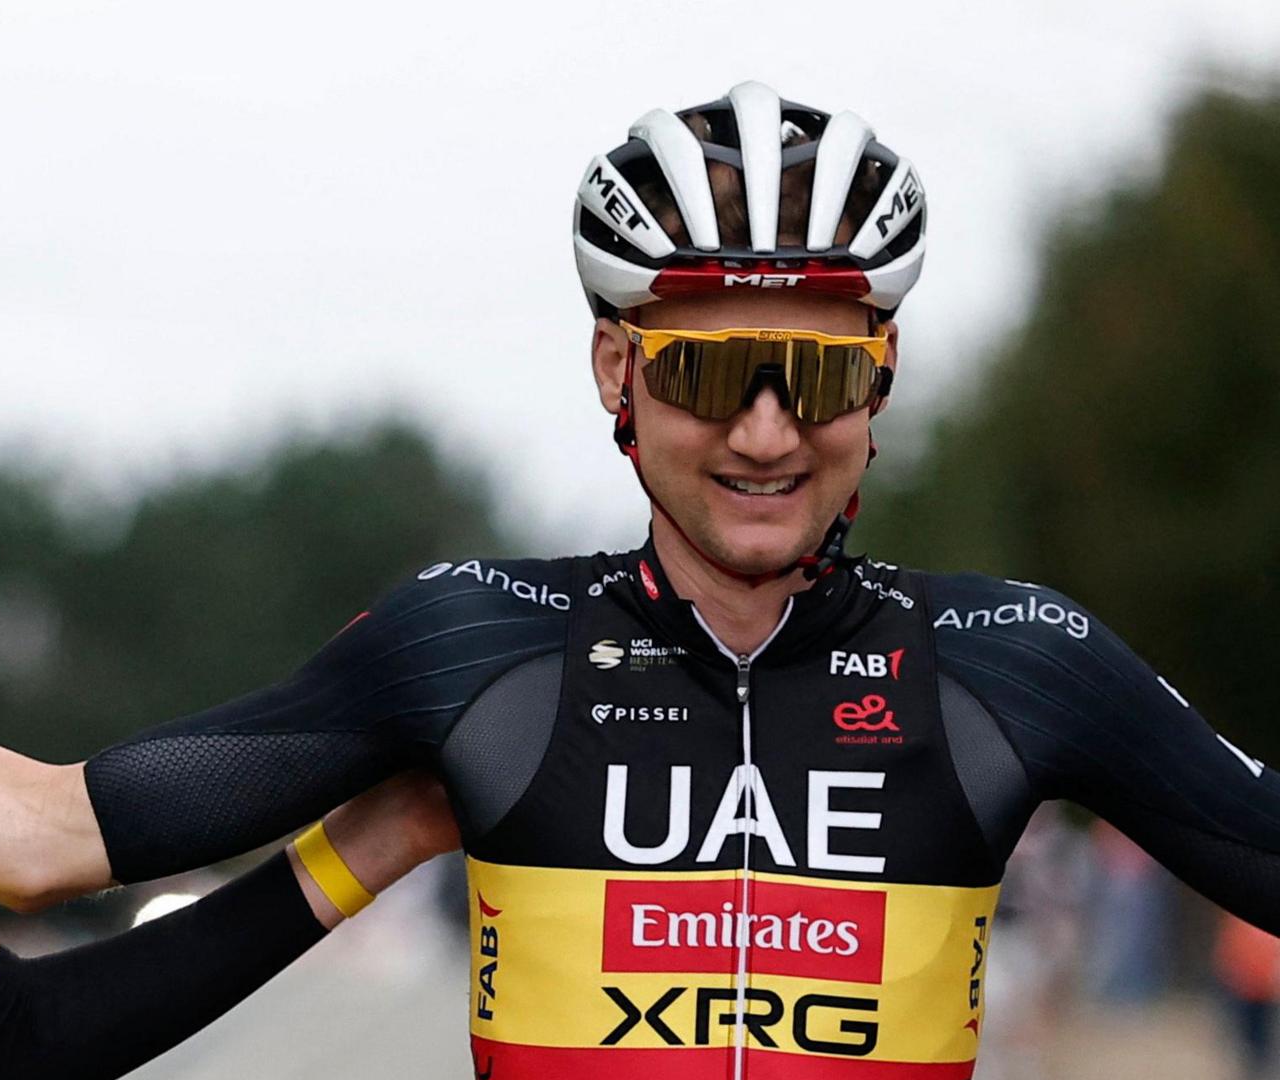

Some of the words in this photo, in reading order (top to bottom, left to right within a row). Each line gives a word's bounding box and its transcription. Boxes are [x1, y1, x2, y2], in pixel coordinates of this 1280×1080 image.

[588, 166, 649, 234] MET
[724, 273, 806, 288] MET
[933, 596, 1090, 639] Analog
[630, 638, 652, 648] UCI
[829, 650, 888, 678] FAB
[615, 707, 689, 721] PISSEI
[602, 763, 887, 874] UAE
[630, 901, 860, 956] Emirates
[476, 925, 499, 1021] FAB
[599, 986, 880, 1056] XRG
